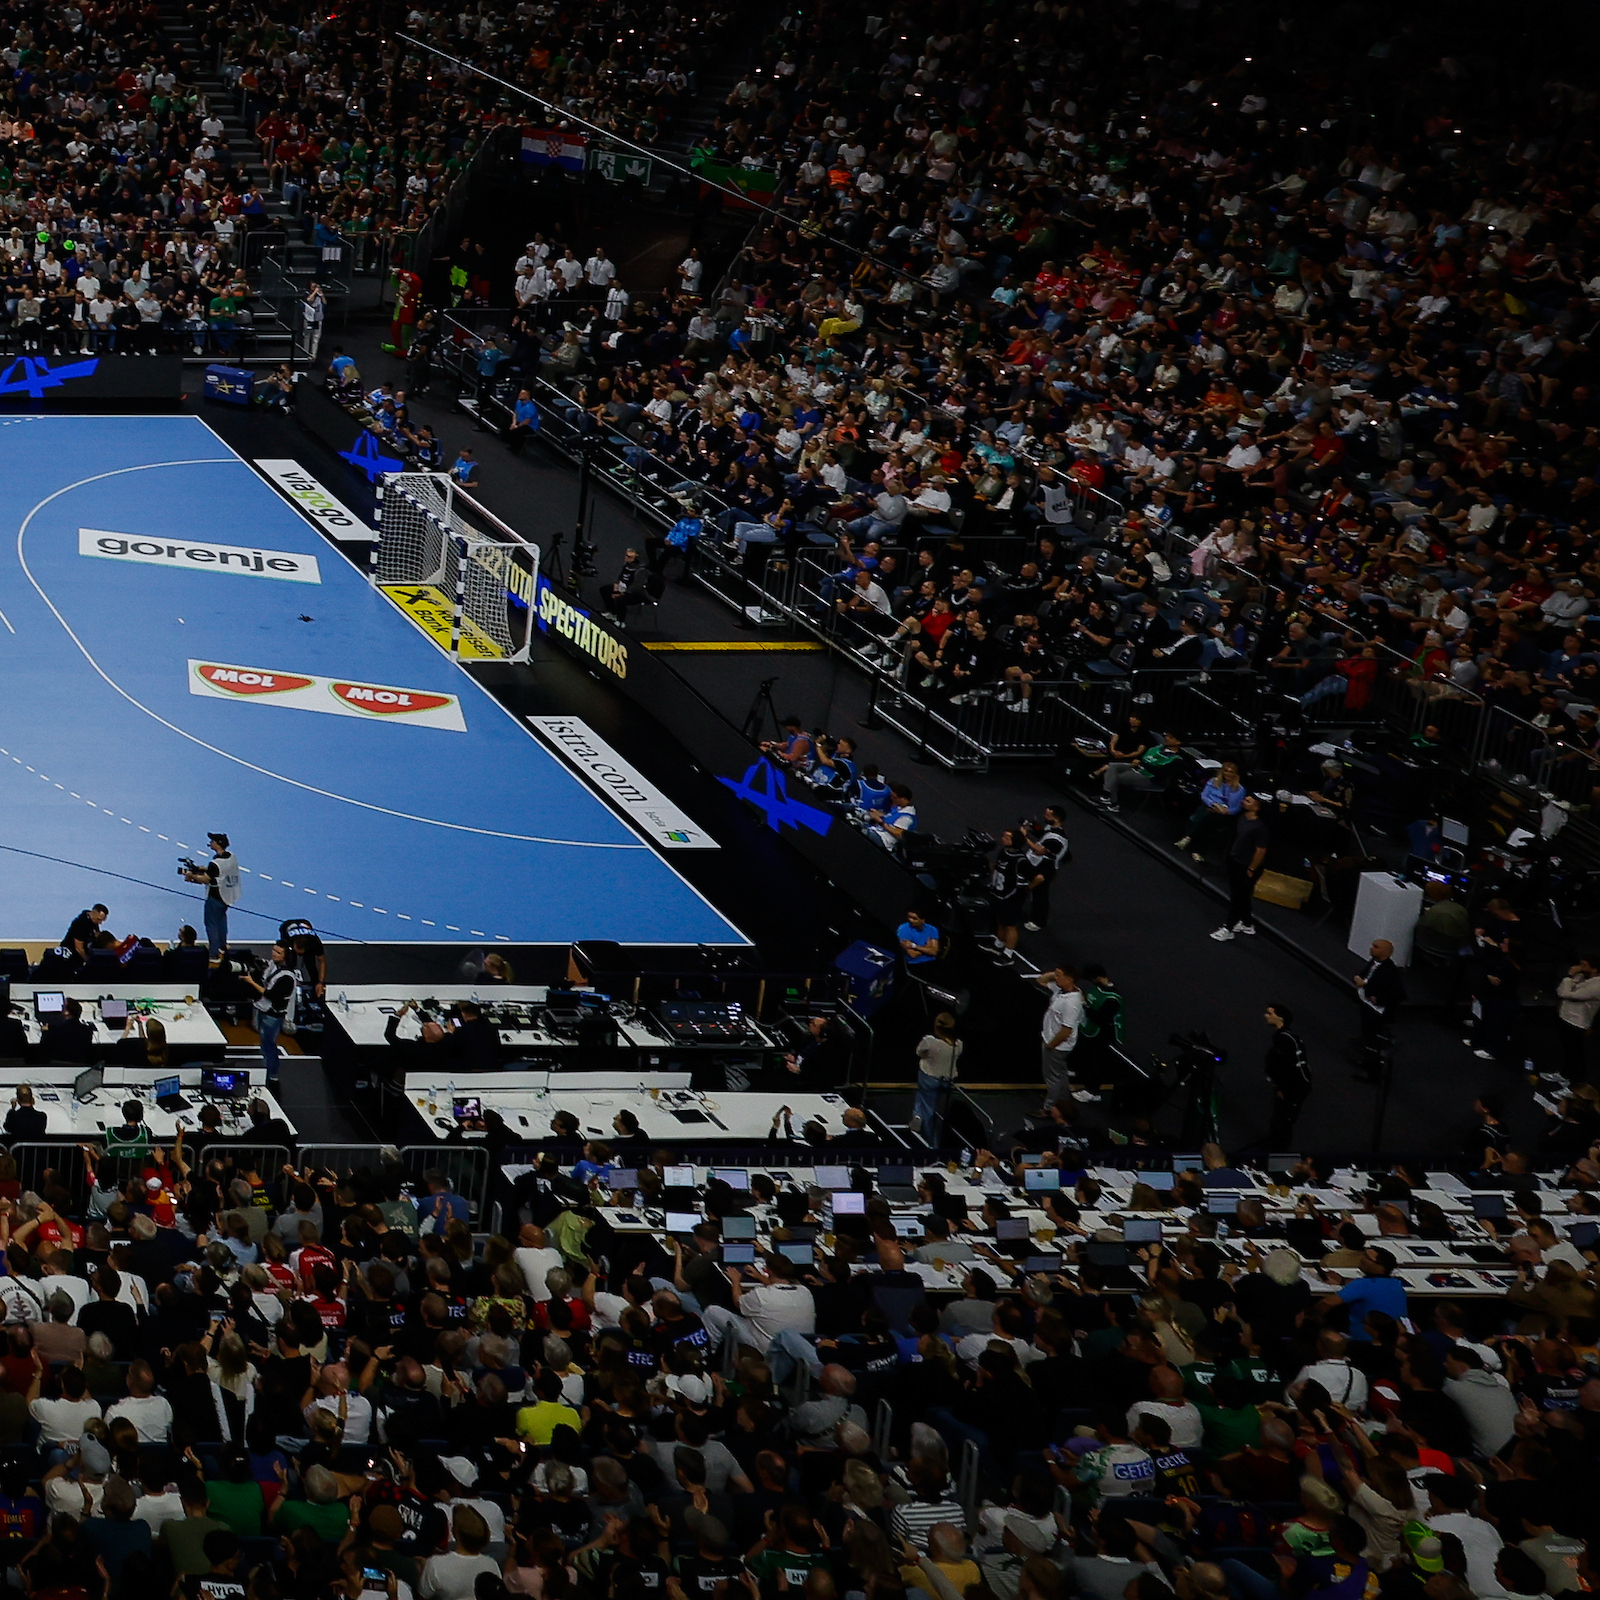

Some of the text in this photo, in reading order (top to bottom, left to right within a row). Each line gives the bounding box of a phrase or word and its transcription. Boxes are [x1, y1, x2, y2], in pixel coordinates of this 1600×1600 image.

[280, 472, 355, 527] viagogo
[96, 535, 300, 572] gorenje
[414, 609, 450, 634] Bank
[540, 586, 629, 680] SPECTATORS
[214, 669, 276, 688] MOL
[347, 687, 413, 706] MOL
[542, 719, 648, 803] istra.com
[628, 1352, 654, 1366] ETEC
